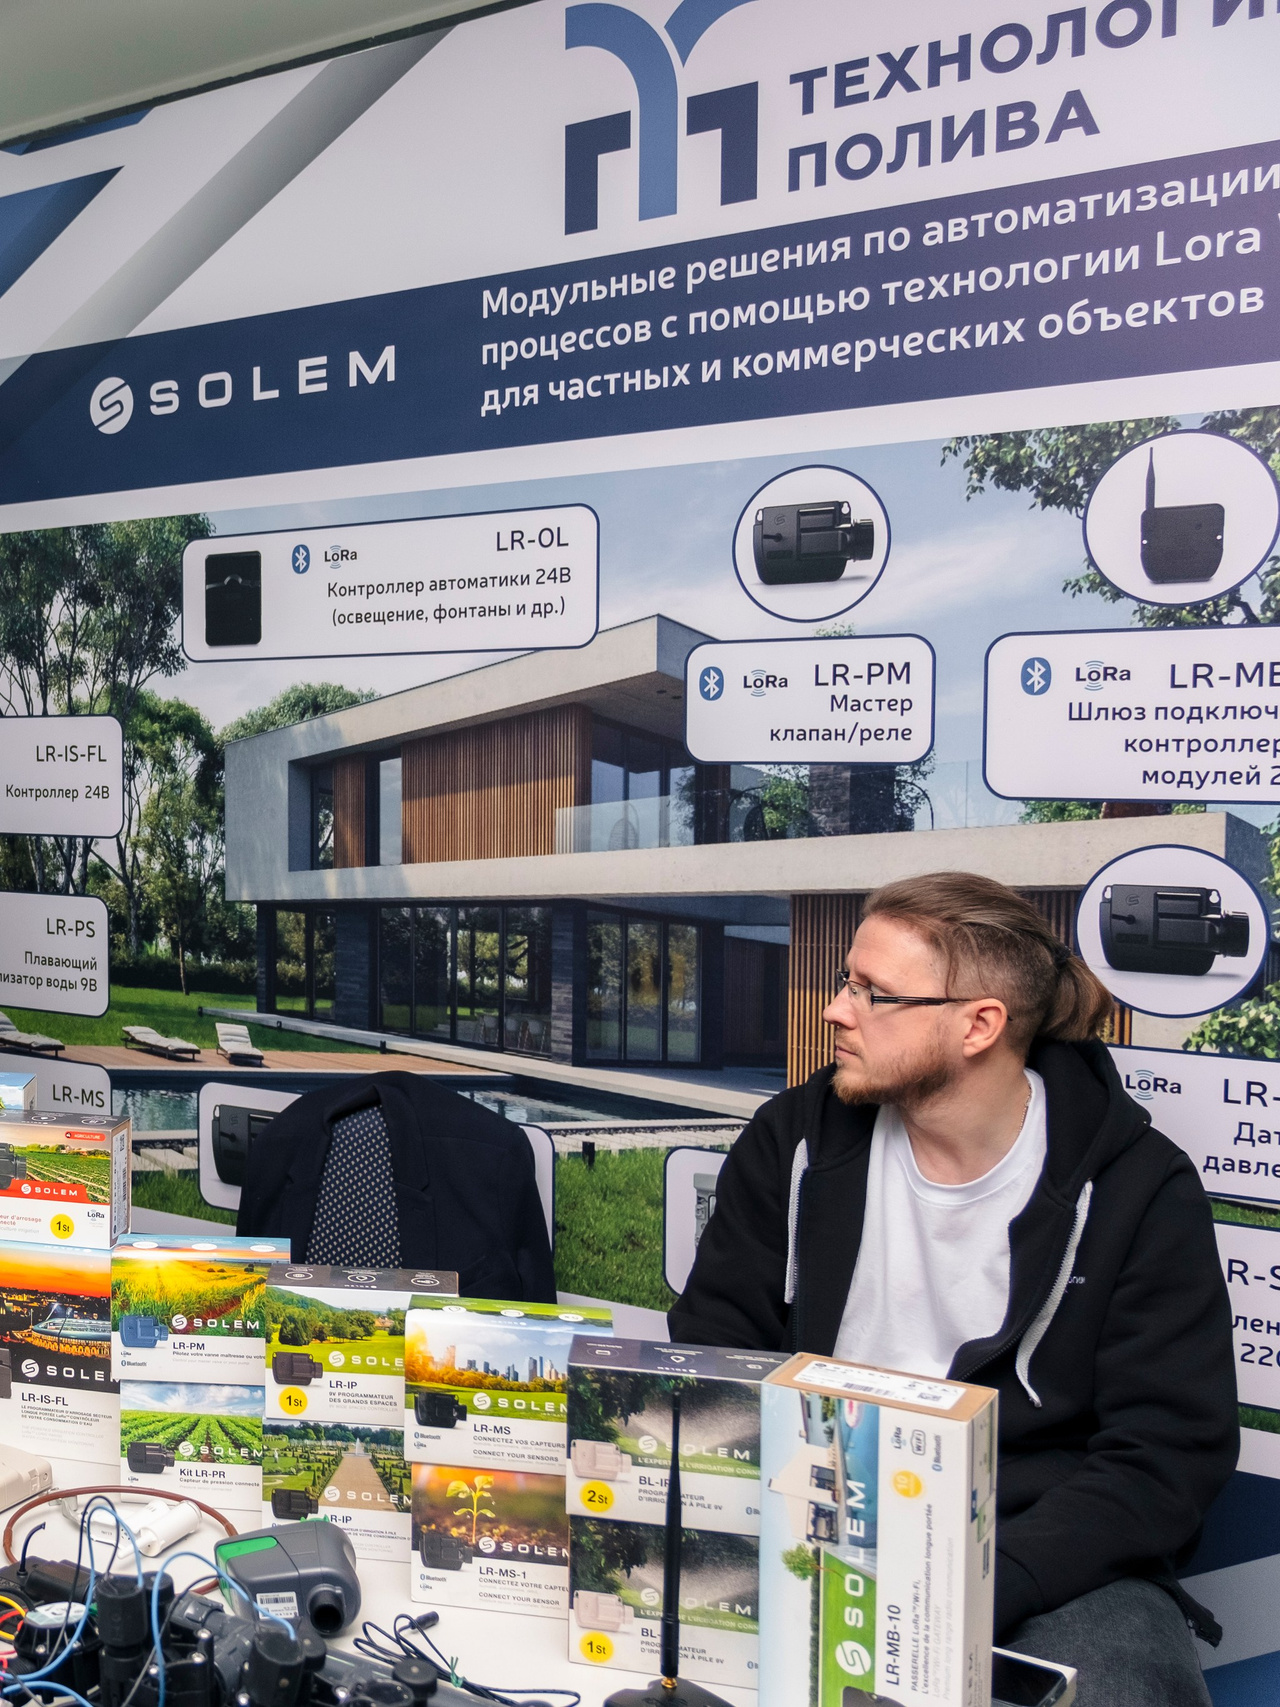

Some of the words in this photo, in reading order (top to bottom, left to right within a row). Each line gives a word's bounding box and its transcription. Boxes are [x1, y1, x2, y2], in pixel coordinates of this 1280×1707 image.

[789, 0, 1280, 115] ТЕХНОЛОГИ
[788, 88, 1100, 193] ПОЛИВА
[482, 266, 677, 318] Модульные
[687, 236, 851, 294] решения
[864, 227, 910, 256] по
[922, 163, 1280, 246] автоматизации
[482, 320, 652, 370] процессов
[661, 315, 678, 339] с
[688, 286, 870, 334] помощью
[881, 245, 1140, 306] технологии
[1156, 227, 1261, 267] Lora
[480, 384, 539, 417] для
[548, 363, 690, 400] частных
[702, 359, 721, 383] и
[733, 318, 1025, 380] коммерческих
[1038, 286, 1265, 340] объектов
[149, 345, 396, 416] SOLEM
[496, 526, 570, 551] LR-OL
[324, 549, 357, 563] LoRa
[328, 580, 424, 599] Контроллер
[429, 573, 531, 591] автоматики
[535, 567, 572, 586] 24В
[332, 609, 428, 626] (освещение,
[433, 603, 511, 623] фонтаны
[516, 603, 526, 615] и
[531, 596, 566, 618] др.)
[743, 675, 788, 688] LoRa
[814, 662, 911, 686] LR-PM
[1075, 666, 1131, 682] LoRa
[830, 694, 913, 716] Мастер
[1068, 702, 1146, 721] Шлюз
[1154, 705, 1279, 724] подключ
[770, 721, 912, 746] клапан/реле
[36, 745, 107, 762] LR-IS-FL
[1142, 765, 1260, 790] модулей
[6, 784, 79, 802] Контроллер
[85, 785, 110, 799] 24В
[46, 918, 96, 938] LR-PS
[24, 950, 97, 971] Плавающий
[46, 978, 77, 991] воды
[81, 977, 97, 992] 9В
[1125, 1073, 1182, 1095] LoRa
[52, 1084, 105, 1107] LR-MS
[35, 1187, 78, 1196] SOLEM
[11, 1213, 42, 1223] d'arrosage
[193, 1318, 260, 1329] SOLEM
[172, 1342, 205, 1351] LR-PM
[1240, 1343, 1280, 1367] 22
[351, 1355, 404, 1367] SOLE
[329, 1380, 358, 1389] LR-IP
[21, 1392, 69, 1406] LR-IS-FL
[338, 1392, 394, 1400] PROGRAMMATEUR
[27, 1405, 64, 1413] PROGRAMMATEUR
[43, 1416, 78, 1424] CONSOMMATION
[473, 1423, 511, 1435] LR-MS
[473, 1435, 513, 1444] CONNECTEZ
[530, 1441, 566, 1449] CAPTEURS
[473, 1449, 505, 1457] CONNECT
[527, 1454, 559, 1462] SENSORS
[179, 1468, 192, 1477] Kit
[195, 1469, 226, 1478] LR-PR
[844, 1480, 866, 1628] SOLEM
[925, 1532, 934, 1560] longue
[479, 1566, 526, 1579] LR-MS-1
[479, 1577, 519, 1586] CONNECTEZ
[479, 1592, 510, 1600] CONNECT
[532, 1598, 560, 1606] SENSOR
[924, 1561, 932, 1623] communication
[886, 1604, 901, 1685] LR-MB-10
[923, 1633, 930, 1643] de
[911, 1638, 920, 1691] PASSERELLE
[922, 1645, 930, 1695] L'excellence
